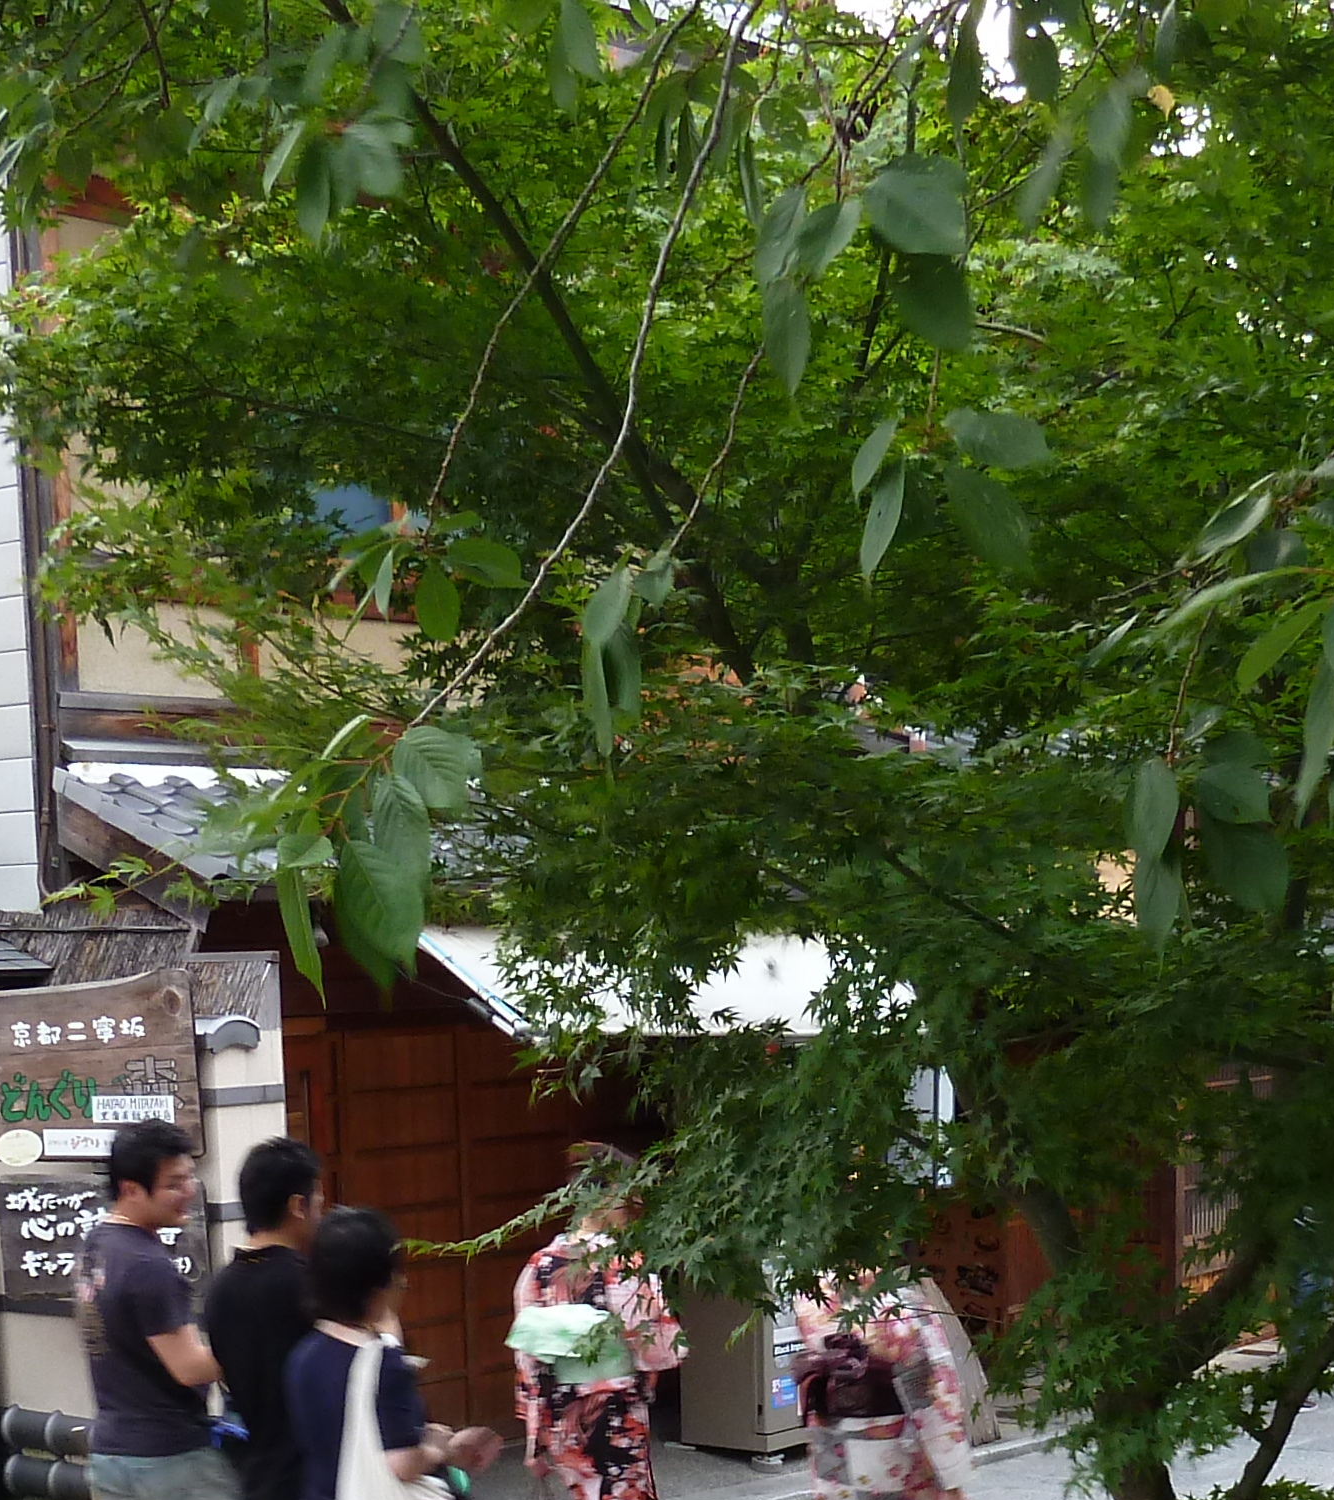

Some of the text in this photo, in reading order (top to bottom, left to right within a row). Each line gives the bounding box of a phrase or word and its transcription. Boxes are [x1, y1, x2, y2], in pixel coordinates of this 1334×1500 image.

[10, 1015, 146, 1048] 京都二寧坂
